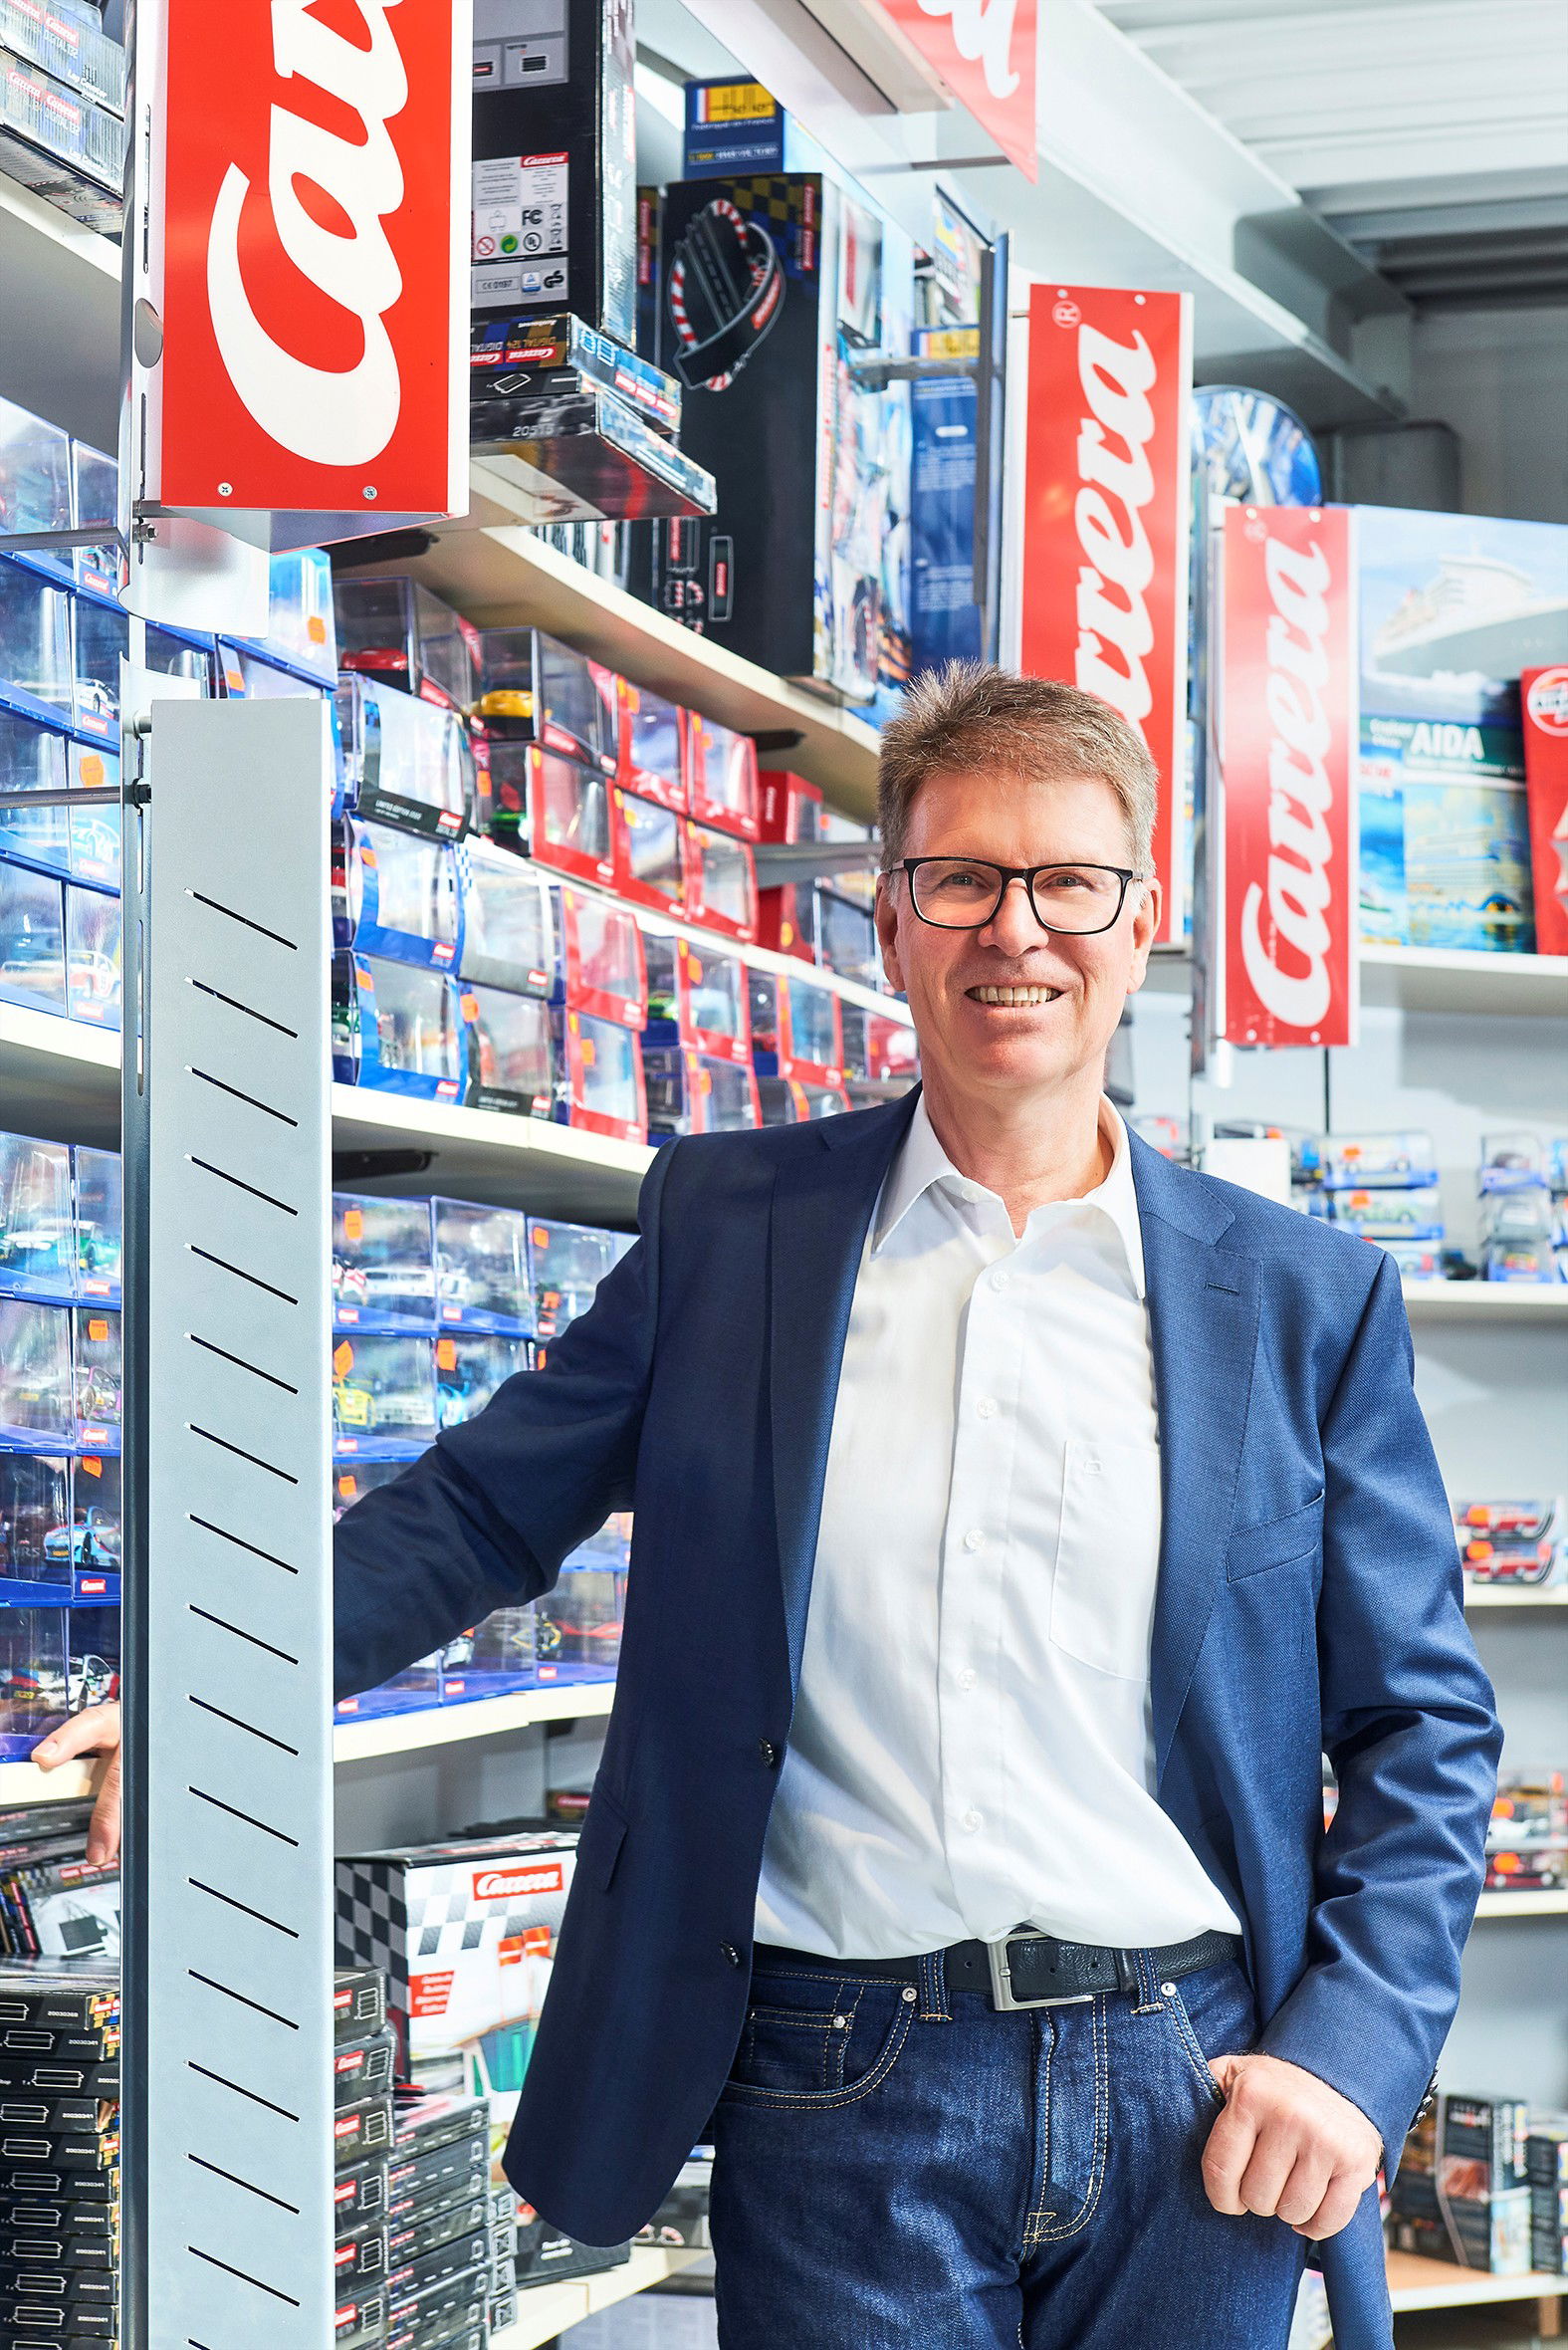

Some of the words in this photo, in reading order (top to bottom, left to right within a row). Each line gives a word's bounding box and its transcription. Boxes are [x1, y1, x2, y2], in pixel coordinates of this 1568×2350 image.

[206, 0, 409, 467] Car
[1074, 323, 1160, 777] rrera
[84, 572, 109, 590] Carrera
[82, 715, 108, 734] Carrera
[1409, 721, 1486, 760] AIDA
[1240, 537, 1333, 1028] Carrera
[476, 1871, 560, 1897] Carrera
